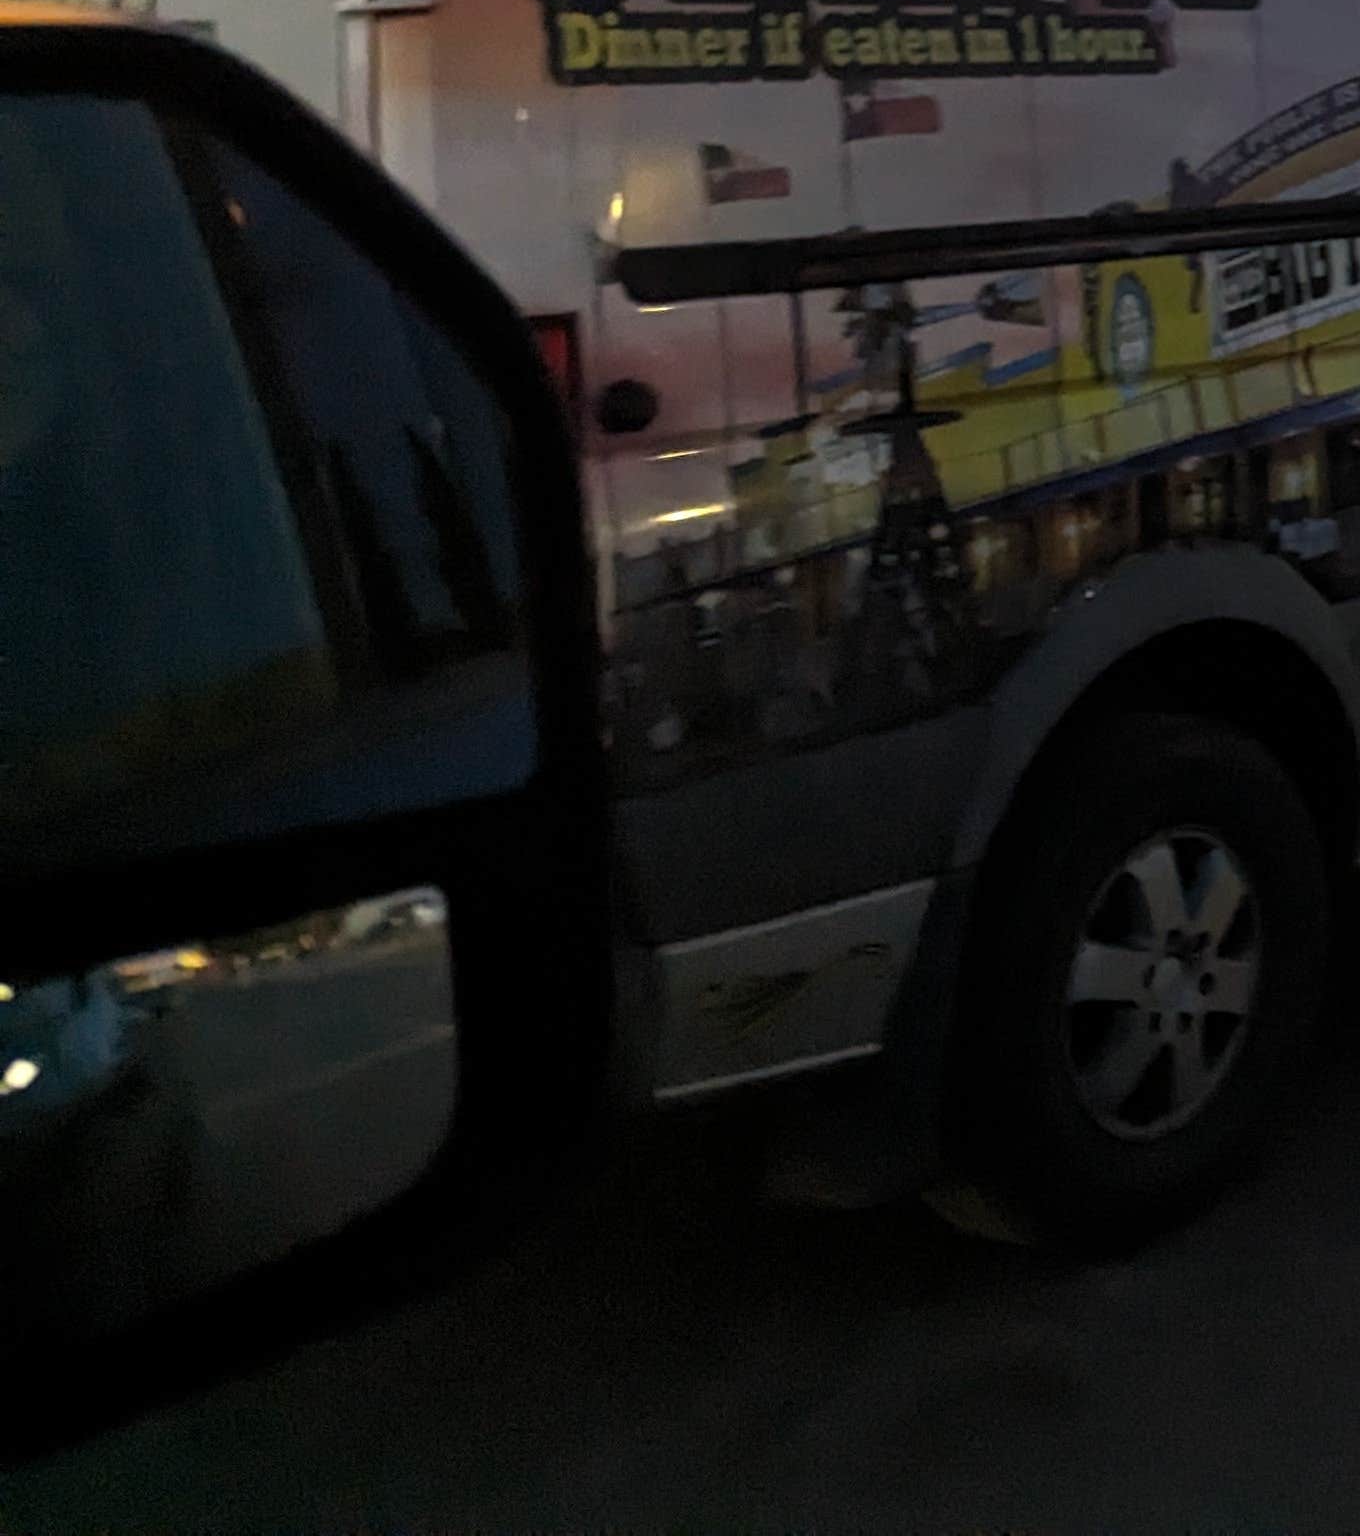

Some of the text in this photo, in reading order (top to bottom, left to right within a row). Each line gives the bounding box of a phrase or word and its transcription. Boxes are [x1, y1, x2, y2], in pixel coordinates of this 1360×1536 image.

[559, 12, 1156, 68] Dinner if eaten in 1 hour.
